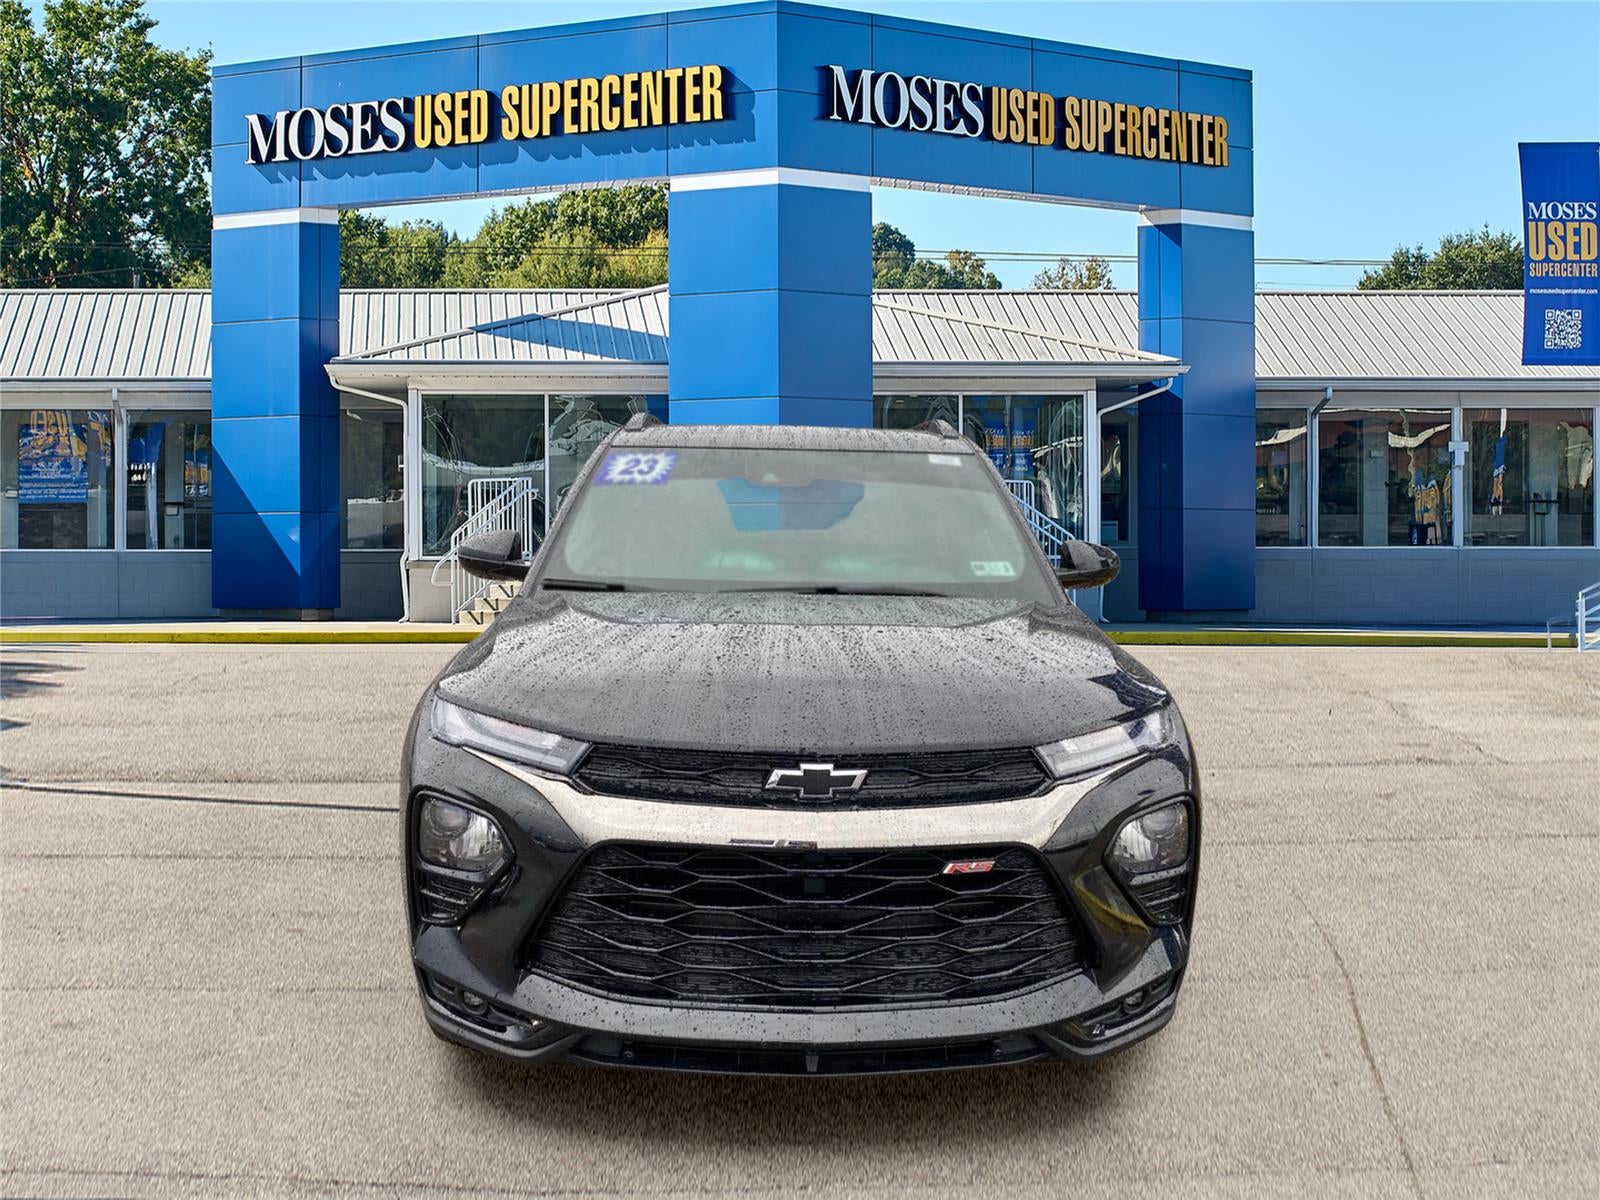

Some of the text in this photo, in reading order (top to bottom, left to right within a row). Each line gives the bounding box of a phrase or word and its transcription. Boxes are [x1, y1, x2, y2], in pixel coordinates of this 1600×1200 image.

[245, 64, 724, 165] MOSES USED SUPERCENTER
[829, 65, 1229, 167] MOSES USED SUPERCENTER
[1528, 201, 1597, 220] MOSES
[1528, 221, 1598, 261] USED
[1529, 263, 1598, 278] SUPERCENTER
[618, 458, 659, 475] 23
[943, 861, 995, 874] RS
